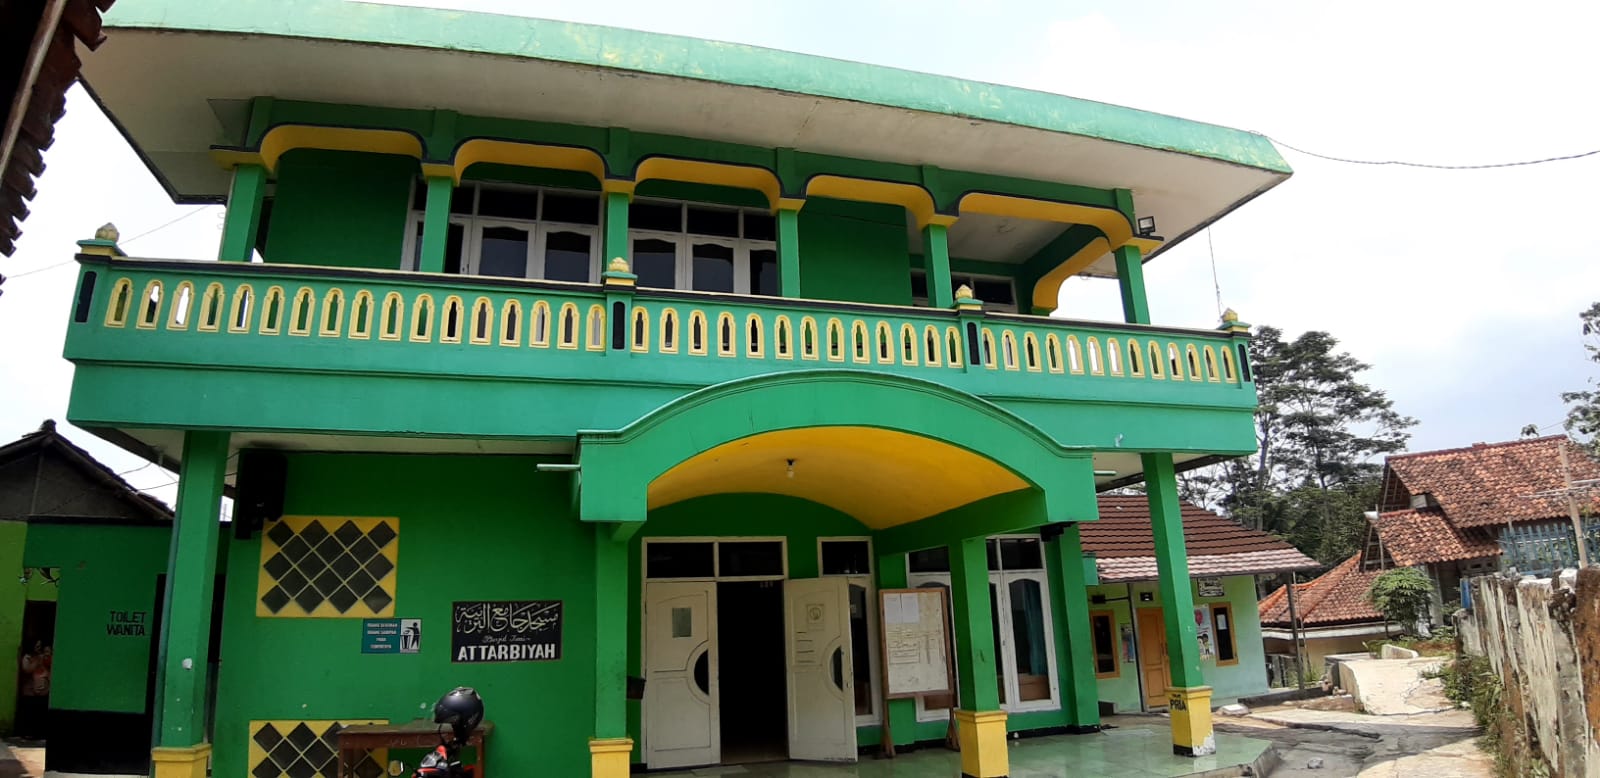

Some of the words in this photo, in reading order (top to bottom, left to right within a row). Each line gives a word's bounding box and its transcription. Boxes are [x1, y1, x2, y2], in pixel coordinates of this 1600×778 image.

[110, 611, 147, 623] TOILET
[107, 624, 145, 636] WANITA
[1170, 699, 1187, 711] PRIA
